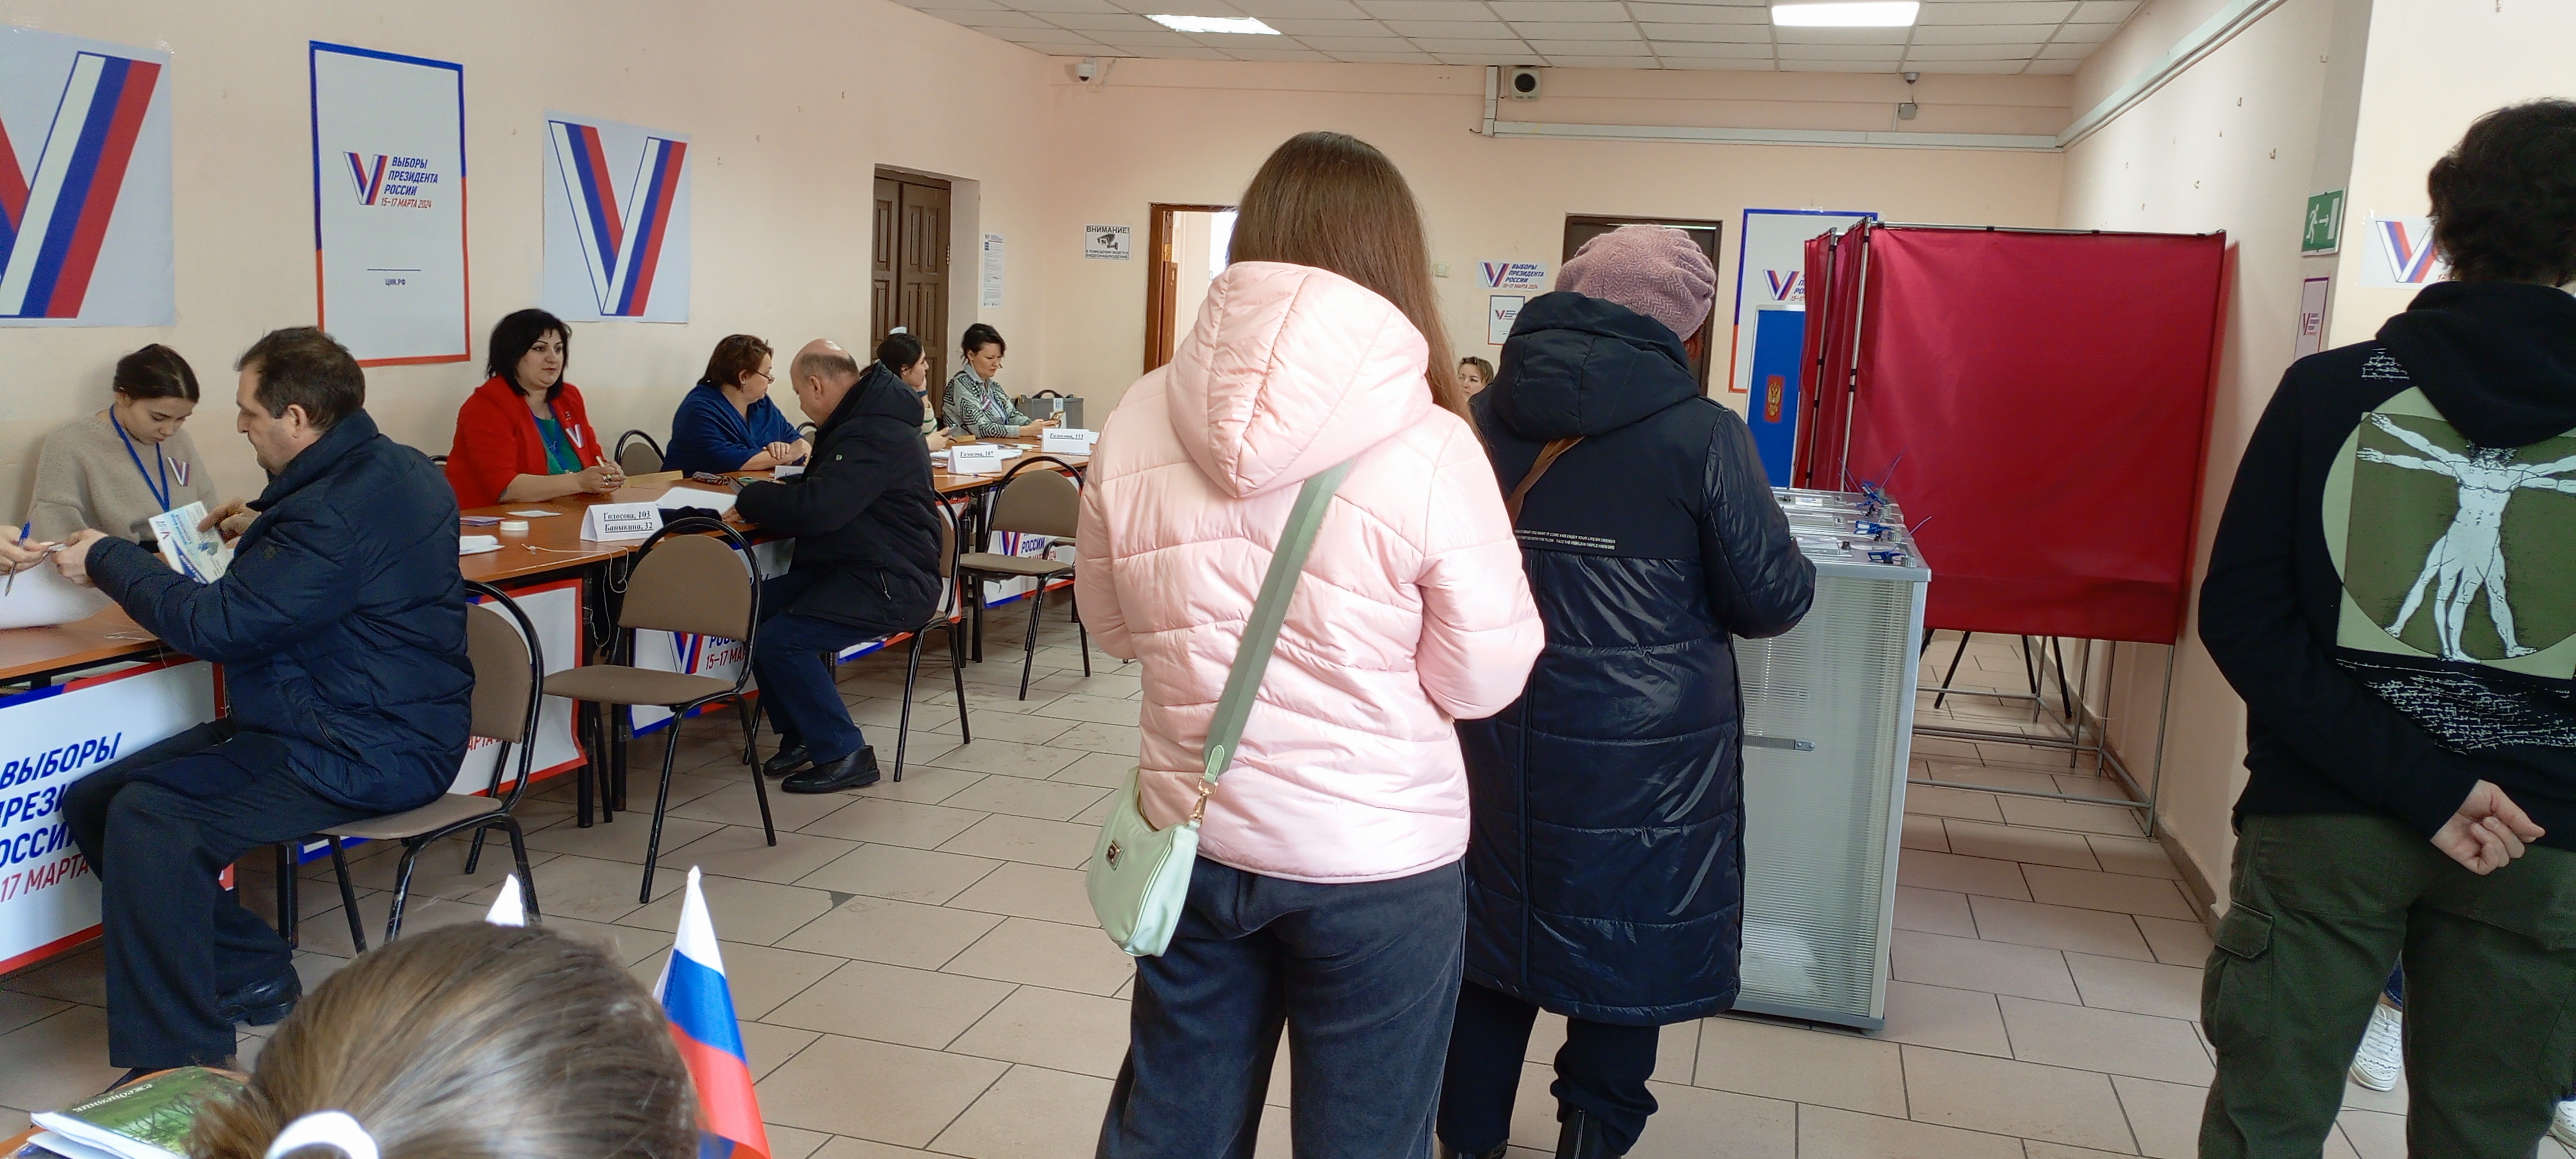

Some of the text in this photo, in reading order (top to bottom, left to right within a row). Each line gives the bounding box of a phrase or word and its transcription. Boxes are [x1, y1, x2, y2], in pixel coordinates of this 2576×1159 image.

[392, 156, 428, 169] ВЫБОРЫ
[388, 170, 438, 184] ПРЕЗИДЕНТА
[384, 183, 417, 196] РОССИИ
[397, 198, 417, 208] МАРТА
[417, 199, 432, 209] 2024
[638, 511, 650, 519] 103
[605, 524, 643, 532] Баныкина,
[1021, 536, 1045, 554] РОССИИ
[0, 732, 122, 789] ВЫБОРЫ
[23, 854, 89, 895] МАРТА
